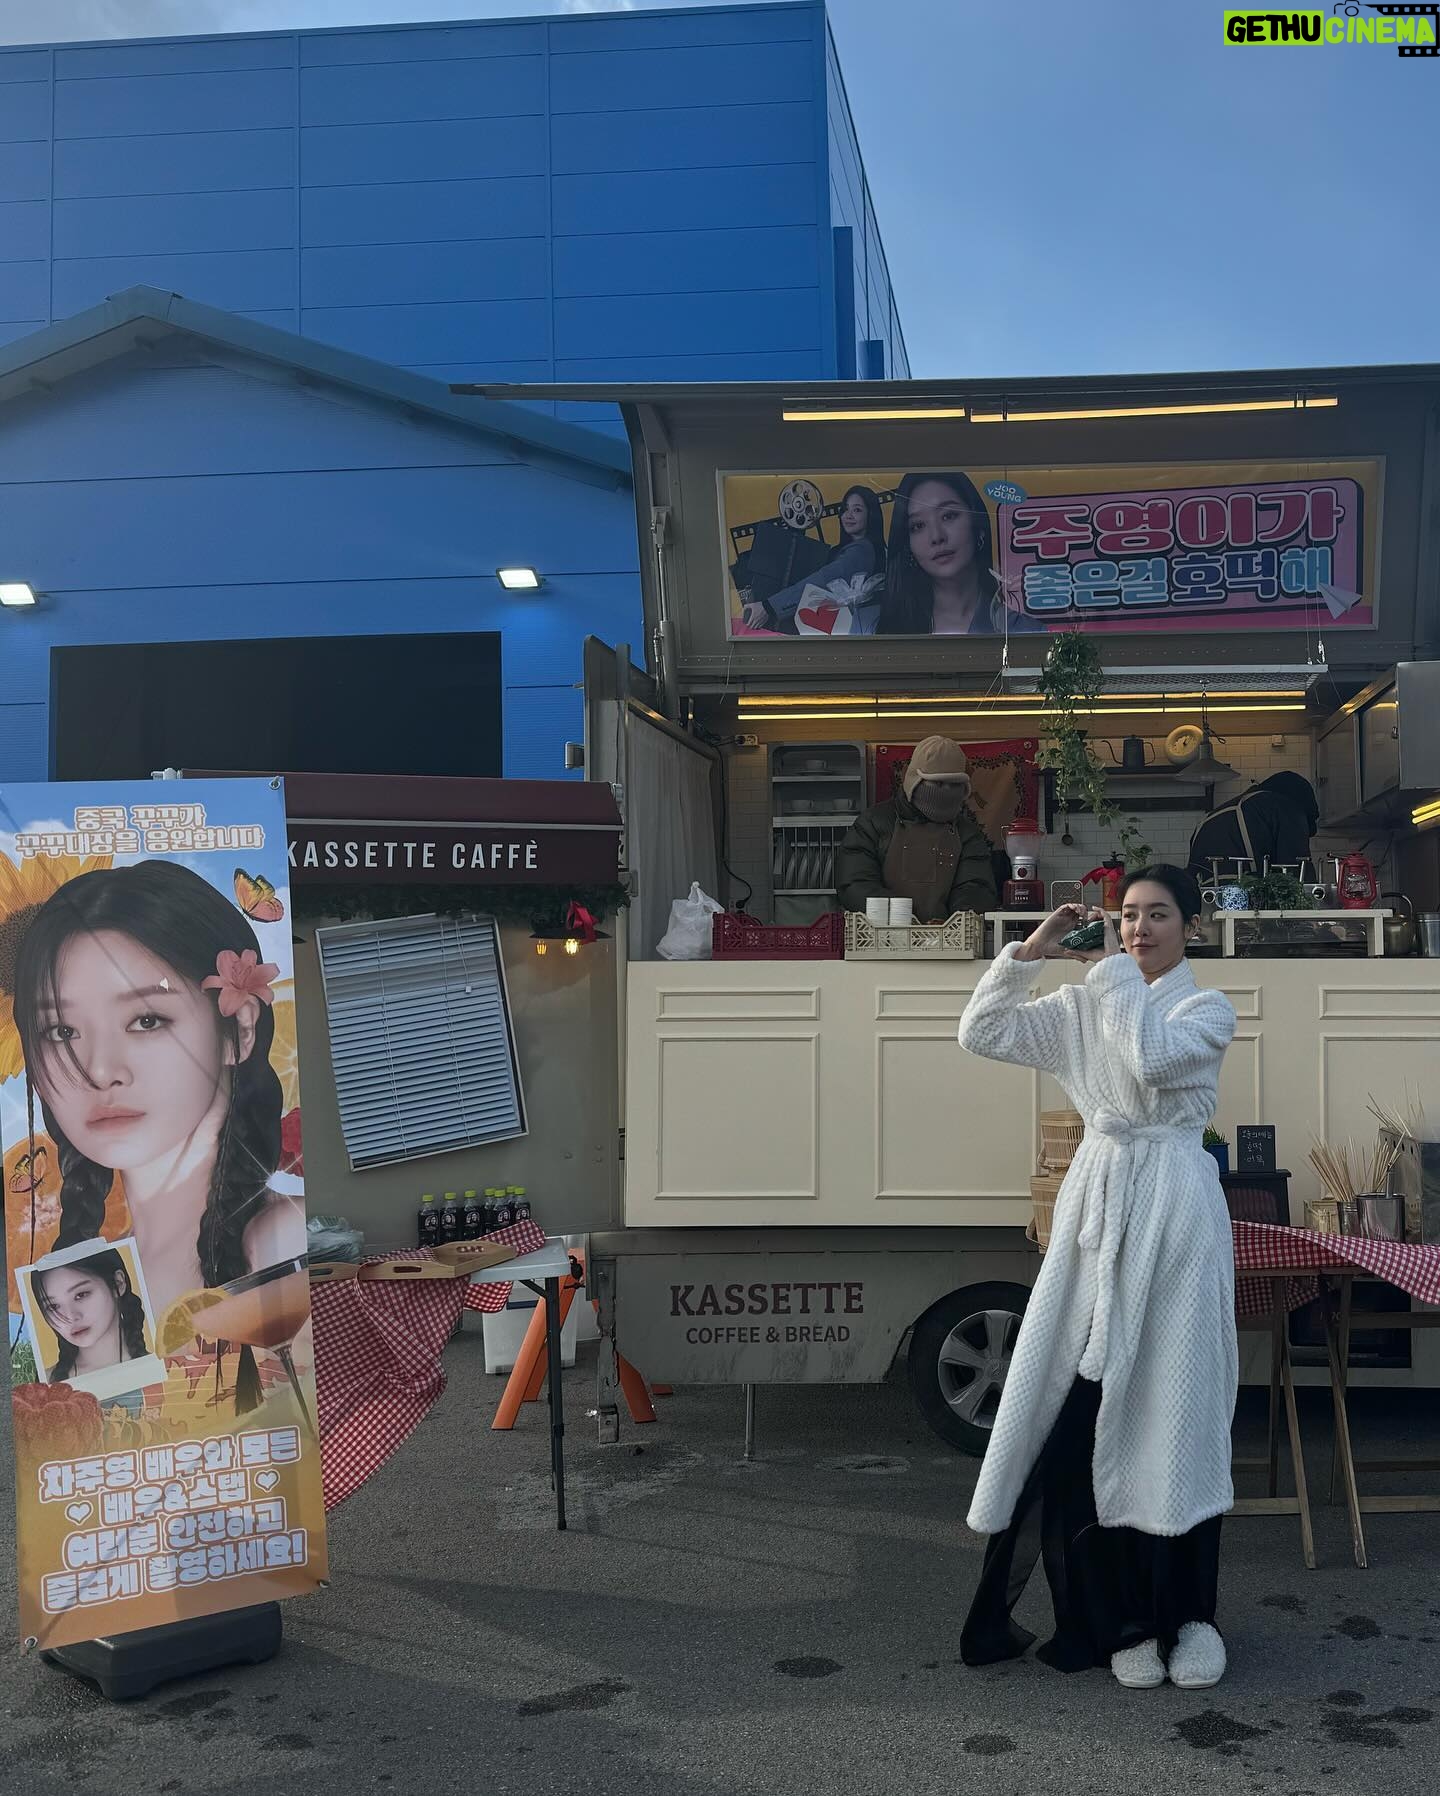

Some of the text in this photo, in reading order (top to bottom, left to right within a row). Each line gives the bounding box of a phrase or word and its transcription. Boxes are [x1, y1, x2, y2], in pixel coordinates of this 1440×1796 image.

[987, 487, 1022, 503] YOUNG
[1011, 488, 1344, 561] 주영이가
[75, 805, 127, 831] 중국
[16, 825, 264, 858] 꾸꾸대장을 응원합니다
[452, 839, 538, 869] CAFFÈ
[670, 1282, 864, 1316] KASSETTE
[686, 1325, 851, 1344] COFFEE & BREAD
[39, 1426, 301, 1502] 차주영 배우와 모든
[62, 1497, 286, 1570] 여러분 안전하고
[42, 1529, 307, 1613] 즐겁게 촬영하세요!
